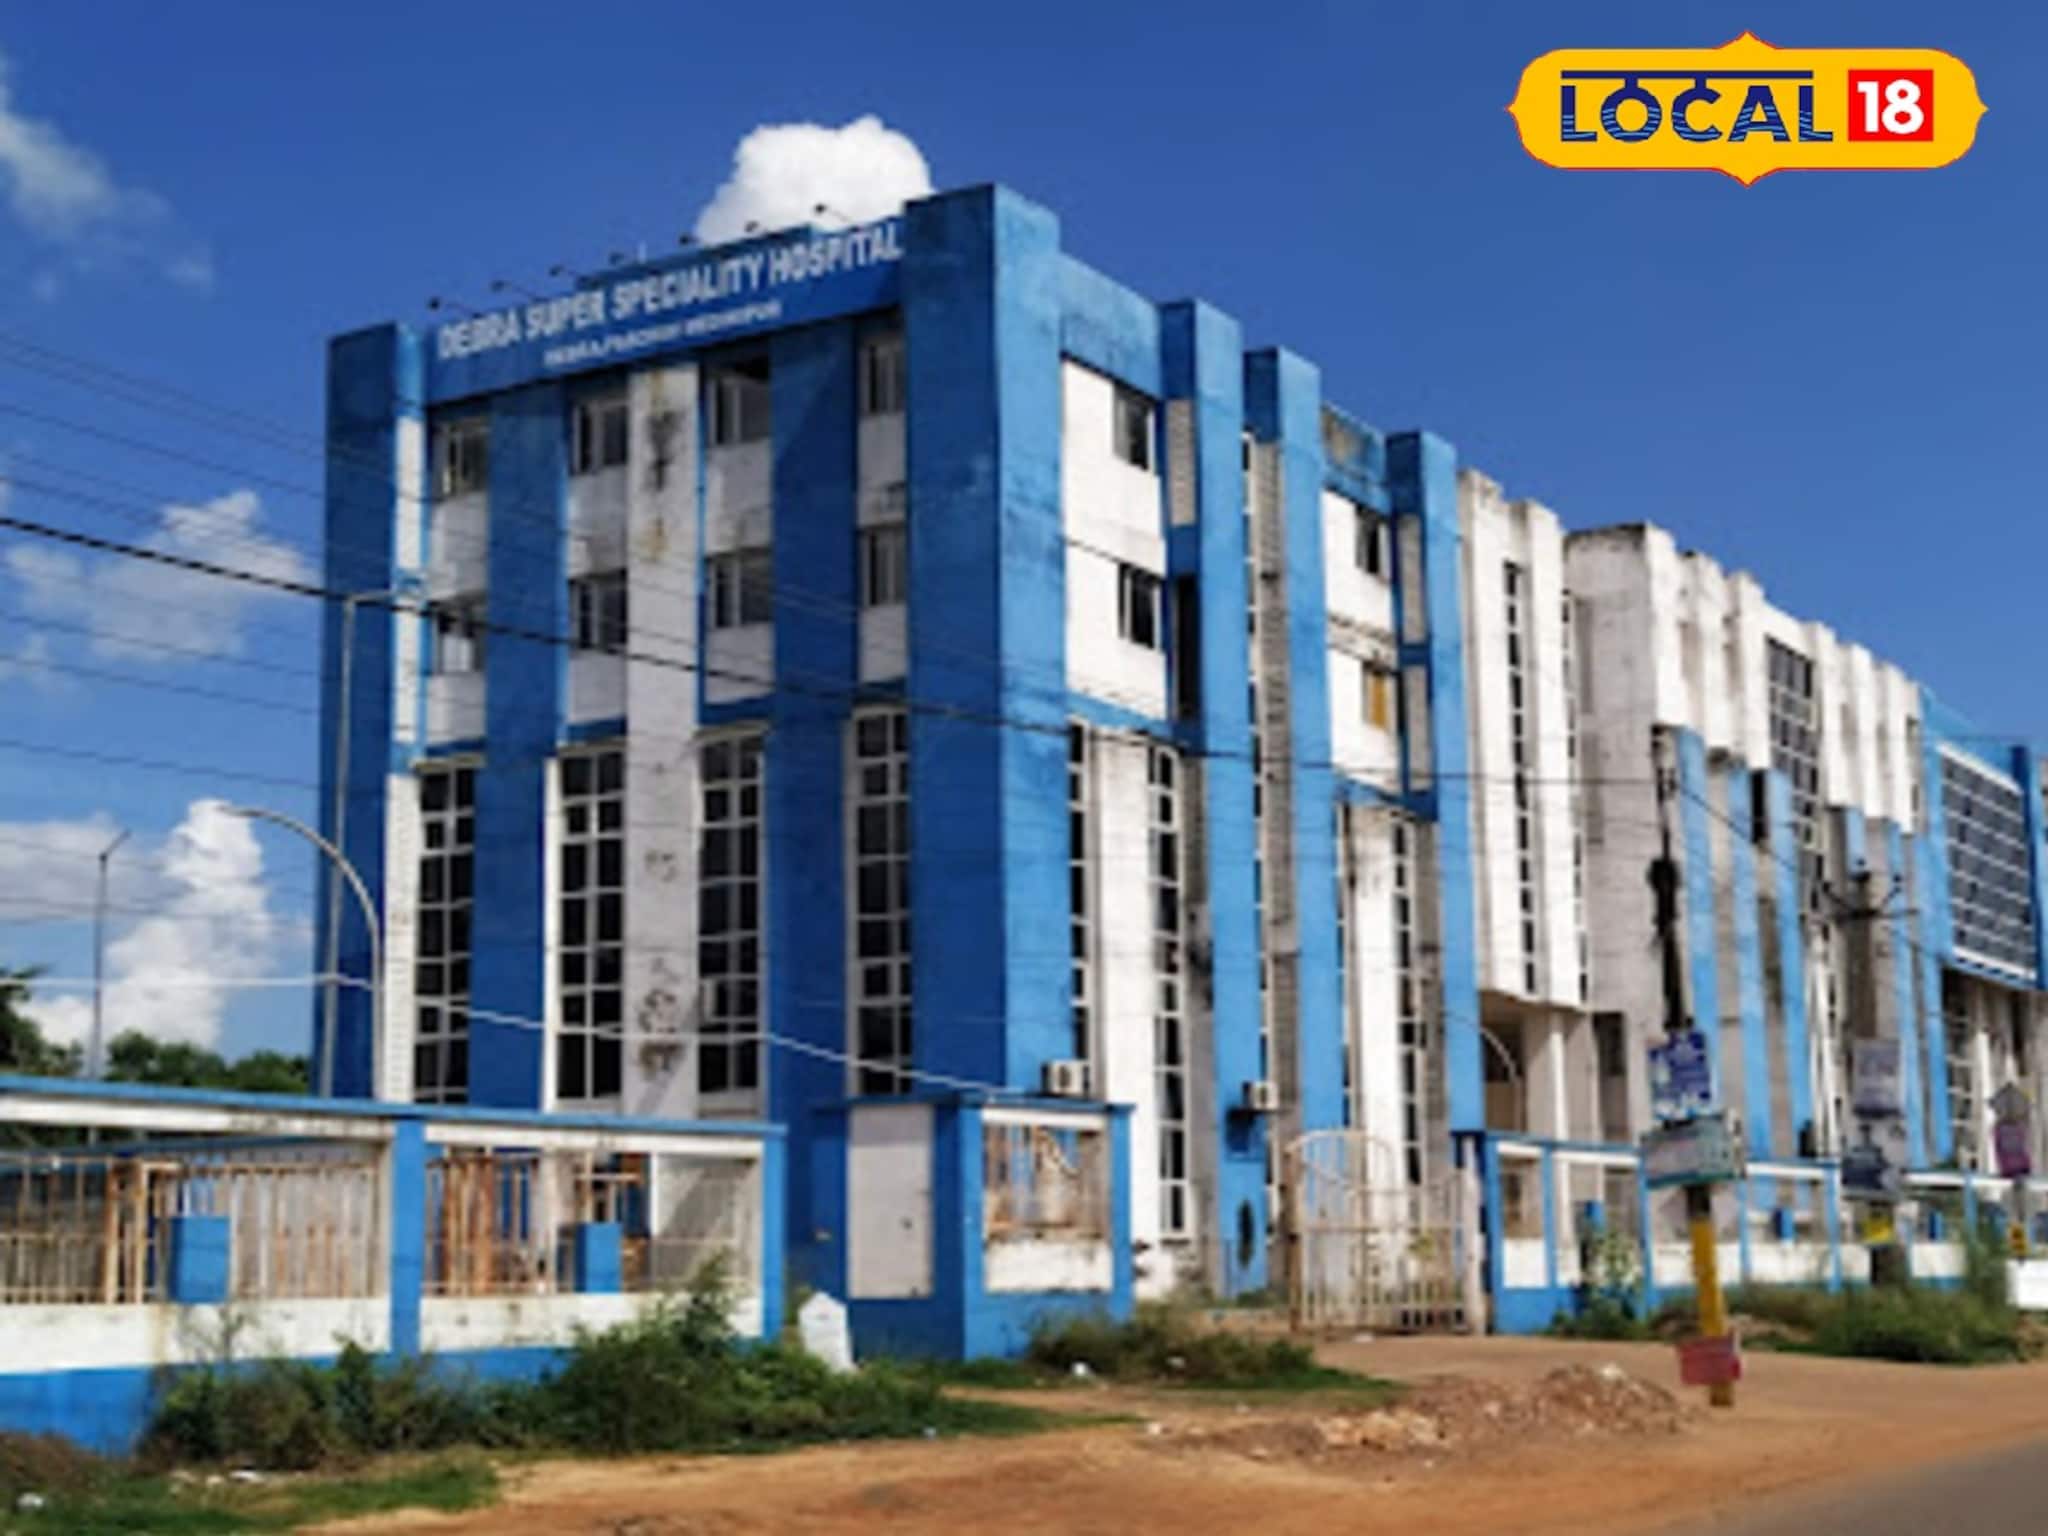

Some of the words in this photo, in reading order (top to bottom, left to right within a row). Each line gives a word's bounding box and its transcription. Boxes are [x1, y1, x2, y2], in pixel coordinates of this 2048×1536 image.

[525, 291, 606, 340] SUPER
[611, 251, 765, 320] SPECIALITY
[769, 223, 903, 286] HOSPITAL
